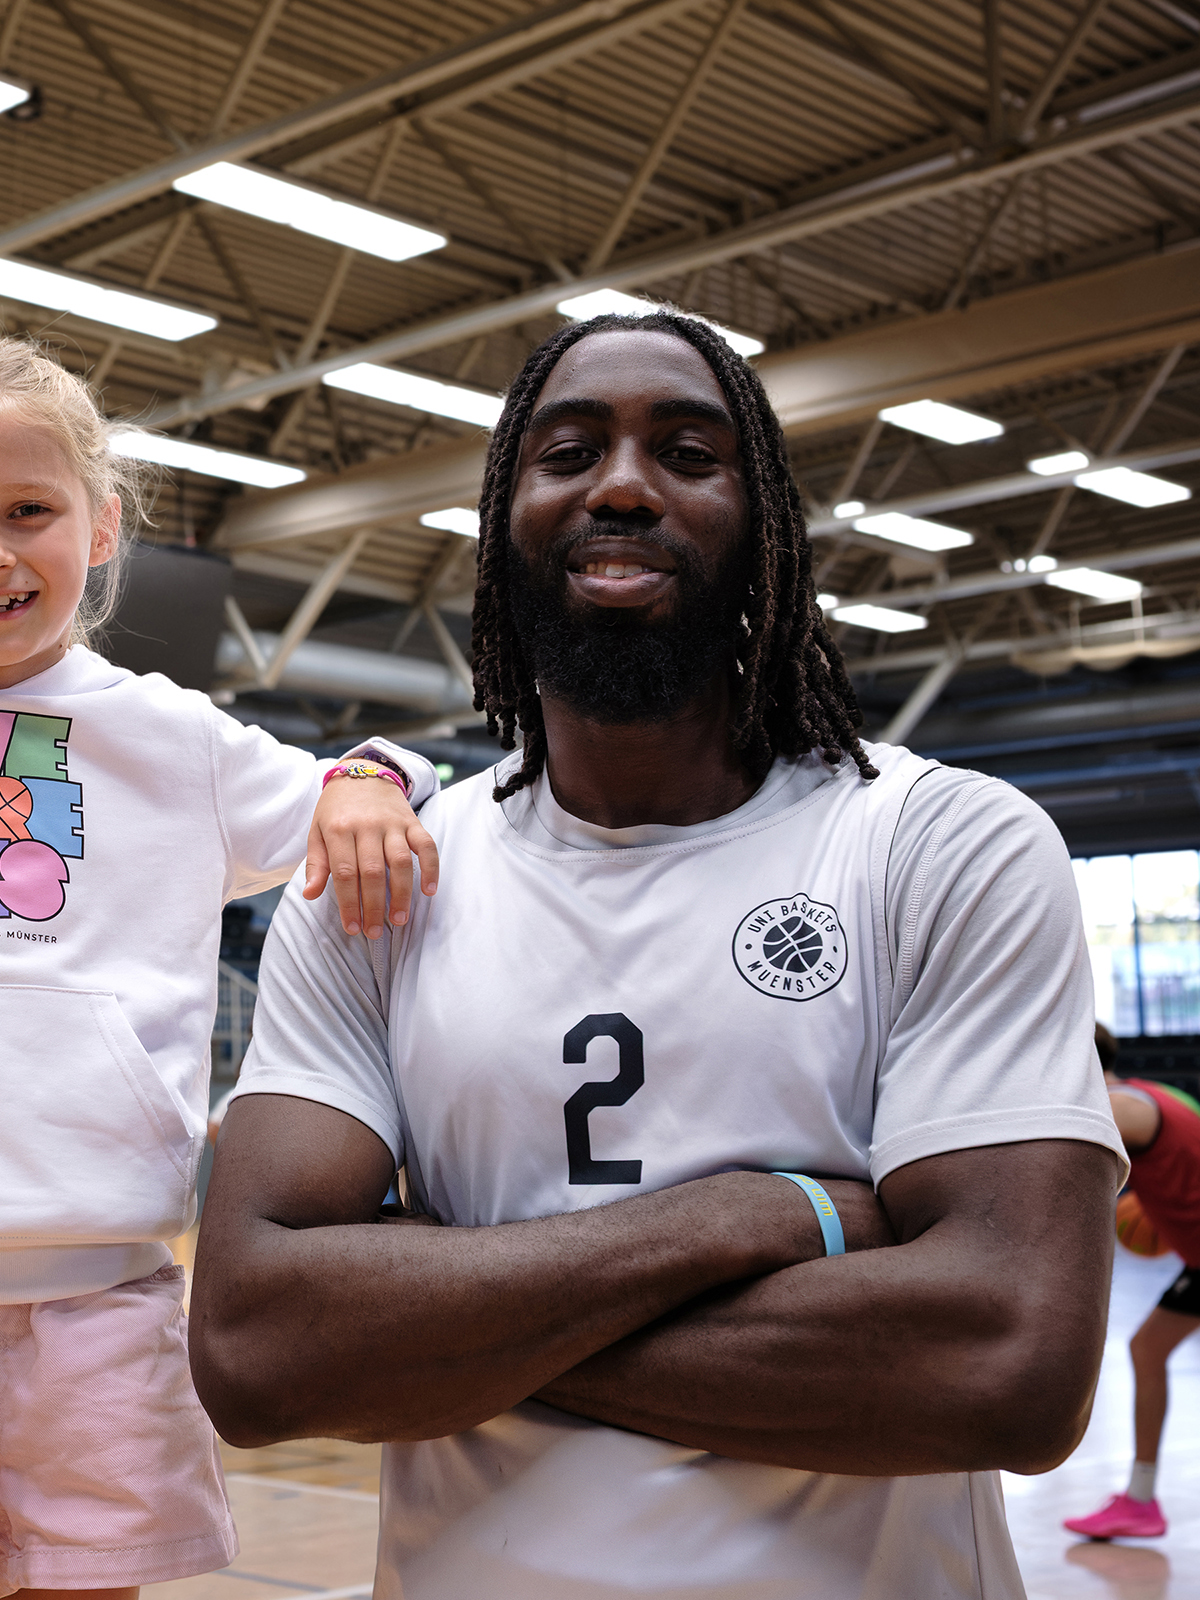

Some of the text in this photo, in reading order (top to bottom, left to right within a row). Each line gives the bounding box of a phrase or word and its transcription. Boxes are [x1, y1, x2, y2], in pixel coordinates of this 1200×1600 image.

[747, 901, 837, 933] UNI BASKETS
[6, 930, 58, 944] MÜNSTER
[747, 960, 837, 993] MUENSTER
[562, 1012, 645, 1185] 2
